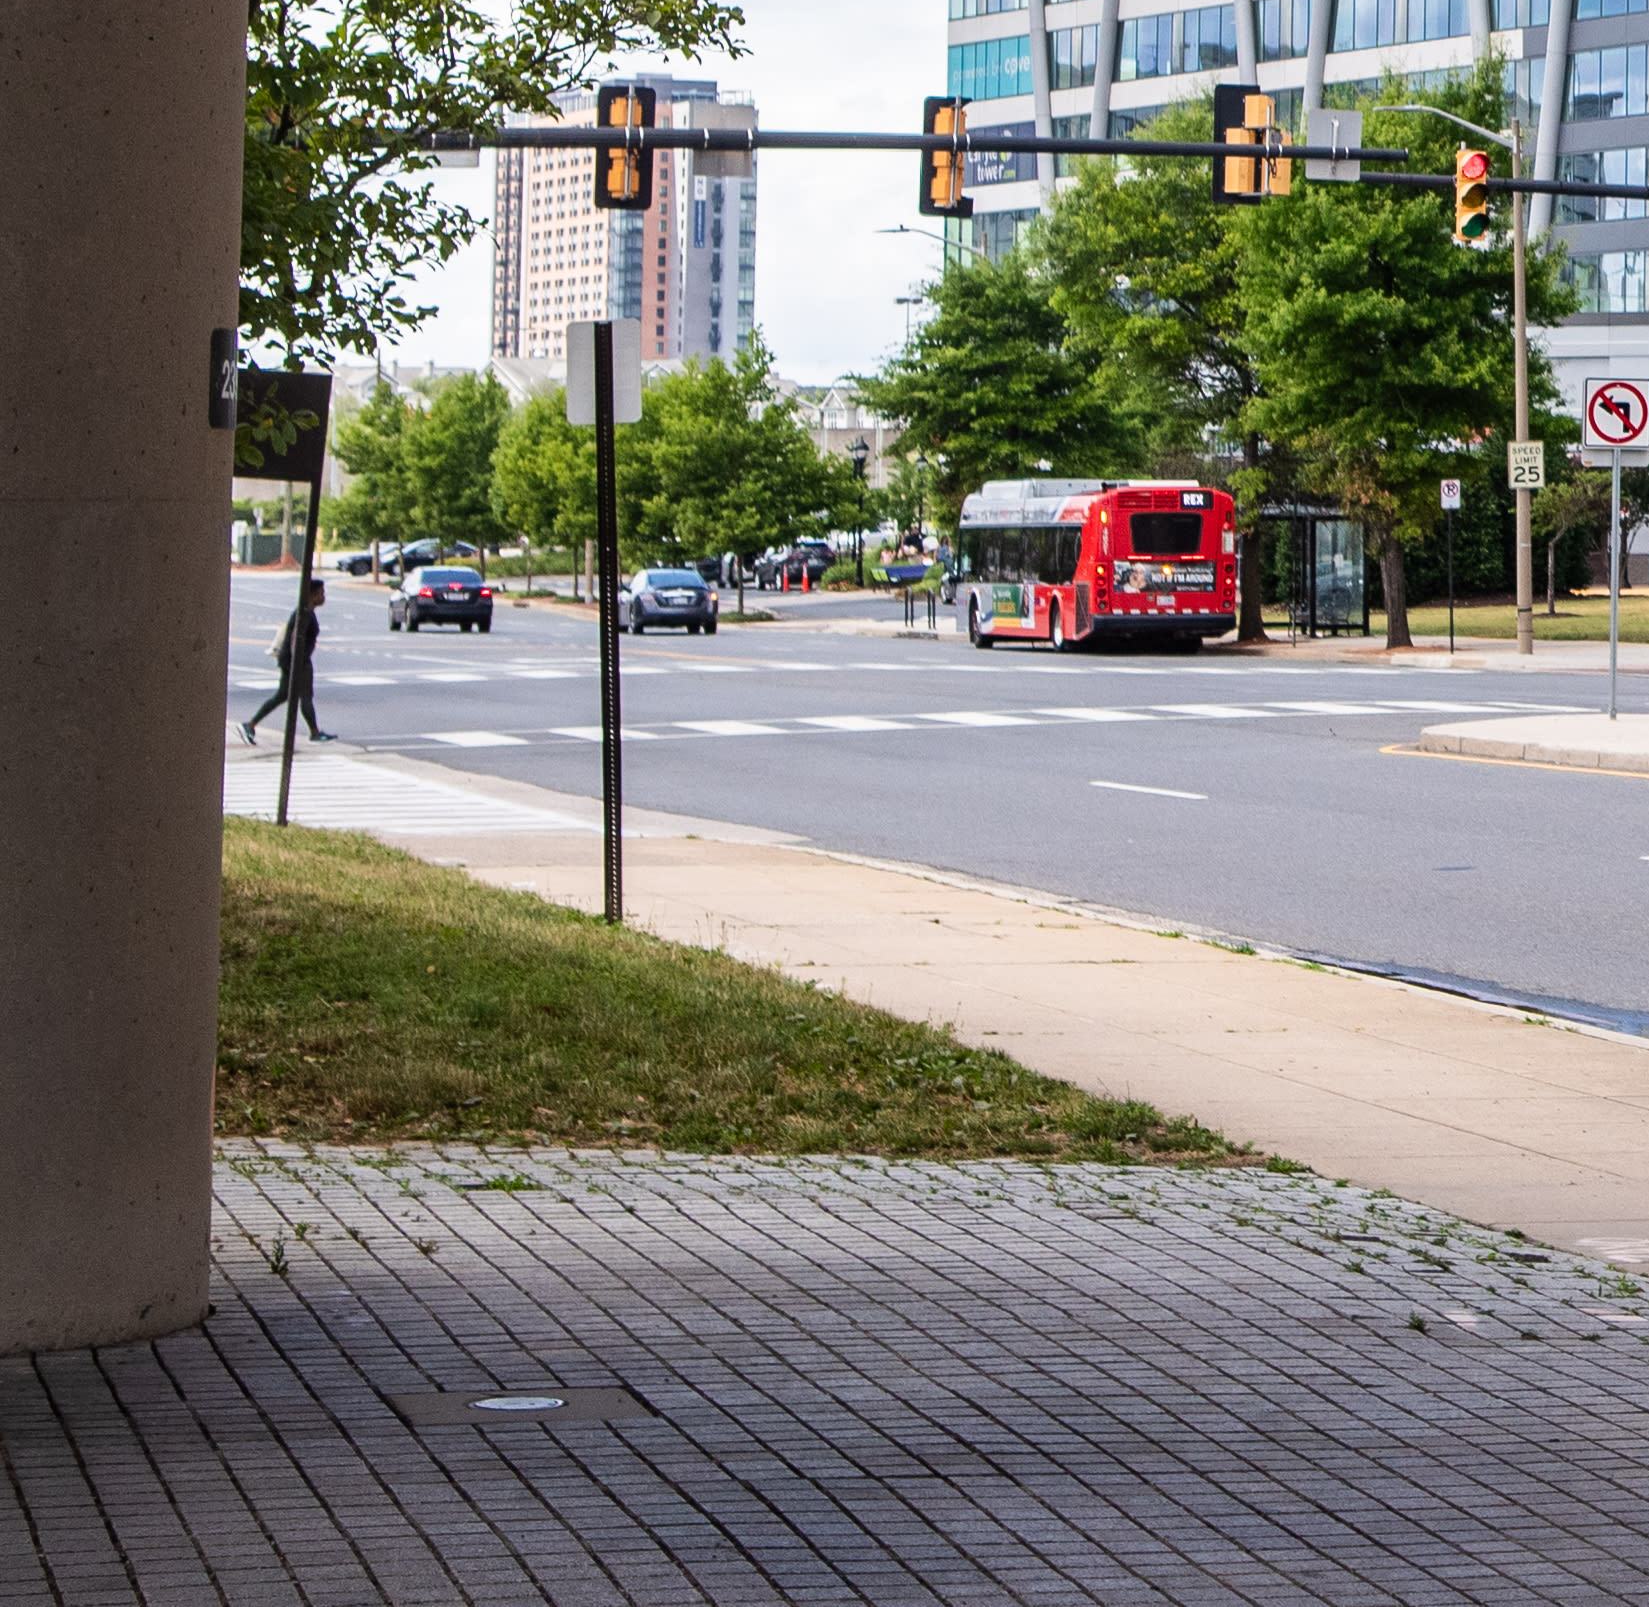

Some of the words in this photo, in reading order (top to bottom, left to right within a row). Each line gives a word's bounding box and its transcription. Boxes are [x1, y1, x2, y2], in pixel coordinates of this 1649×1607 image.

[1512, 446, 1541, 455] SPEED
[1515, 456, 1538, 465] LIMIT
[1514, 466, 1540, 483] 25
